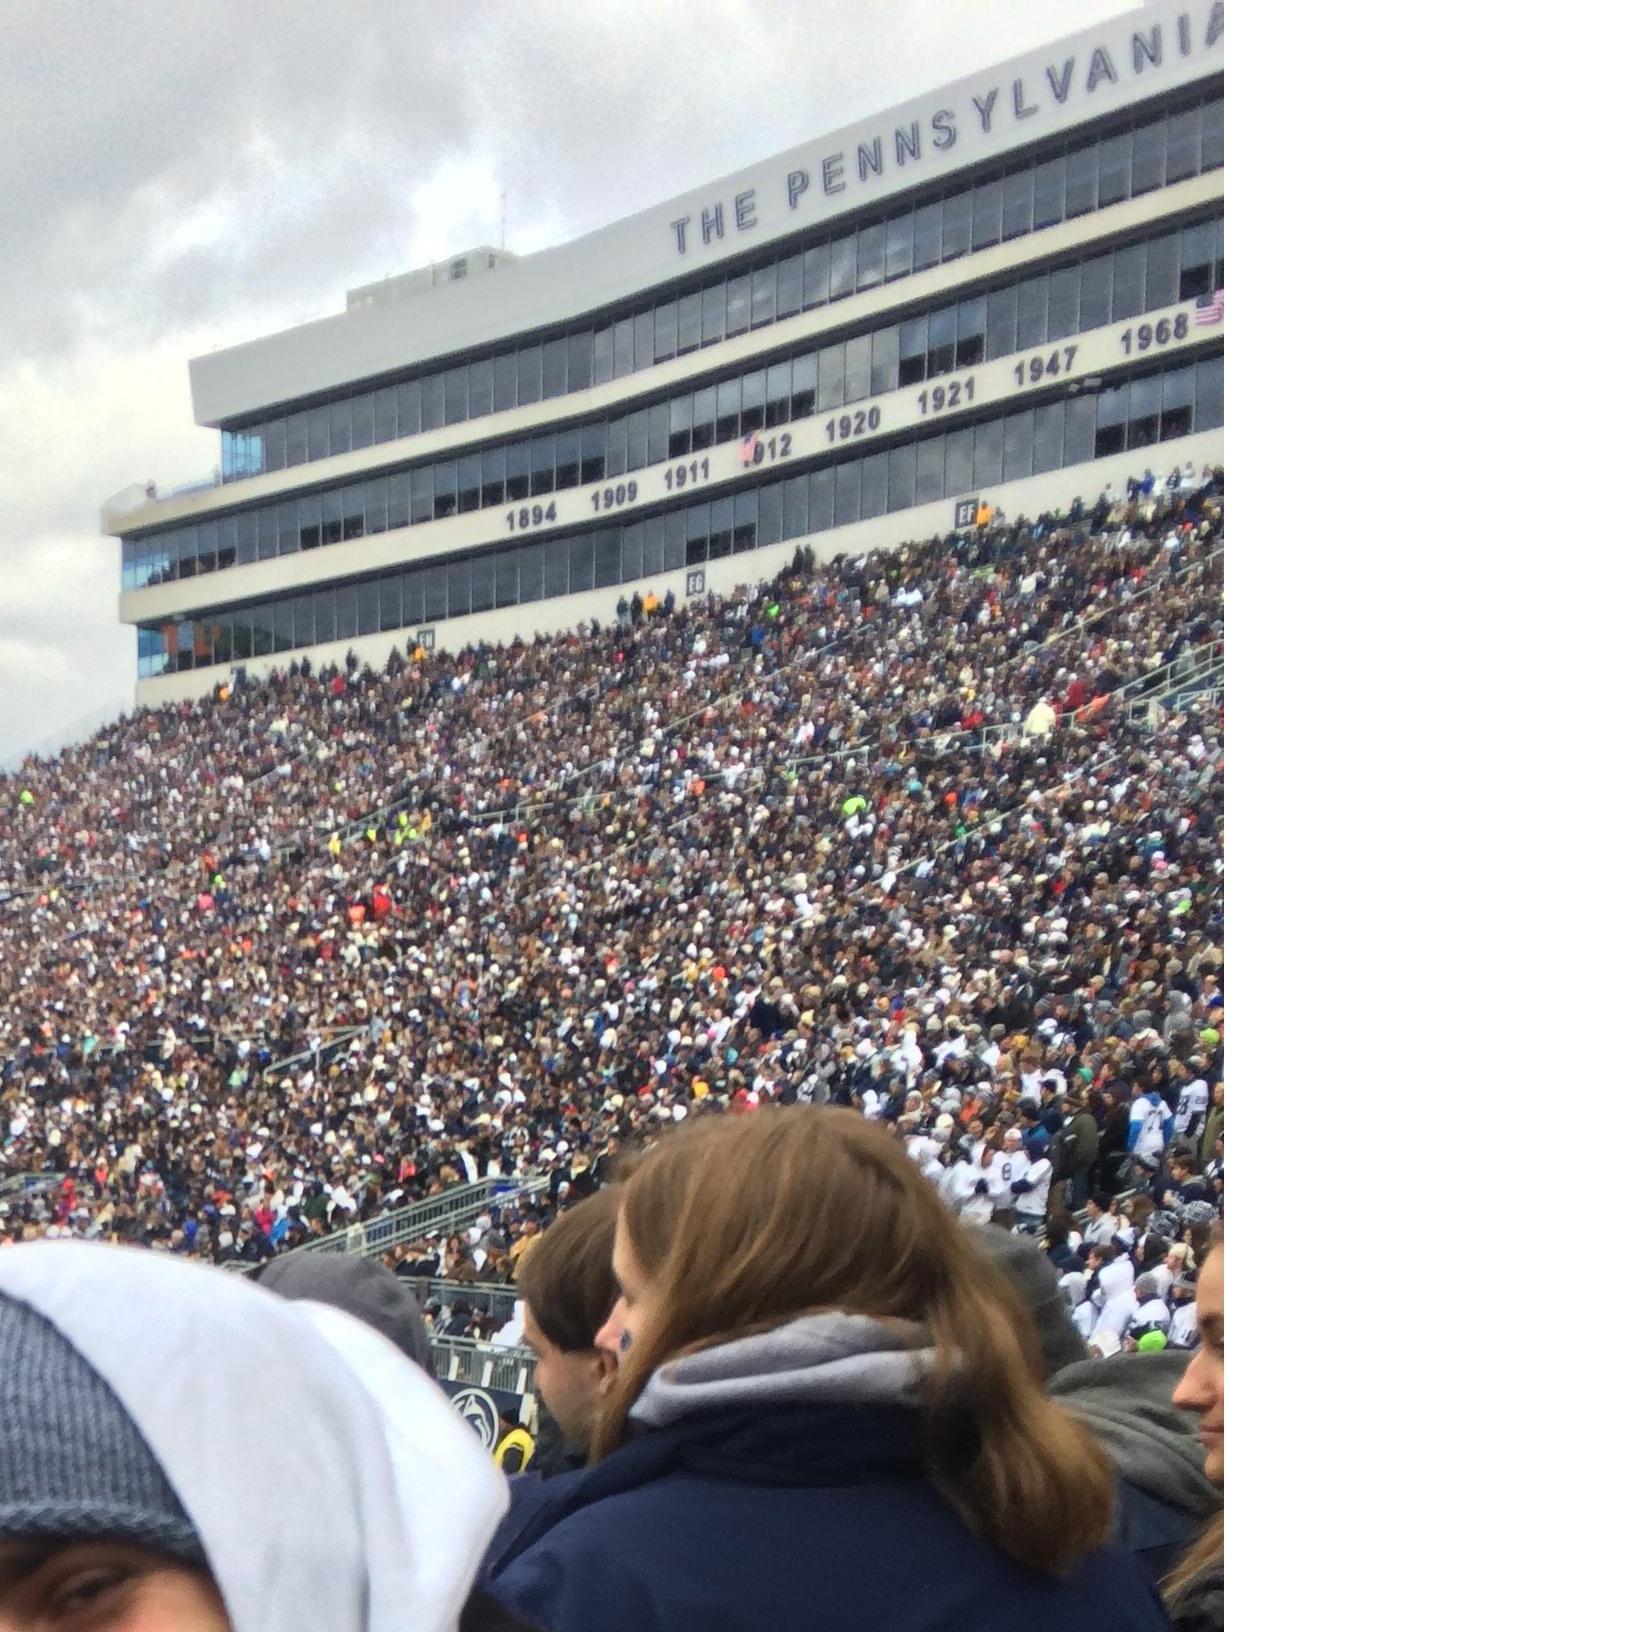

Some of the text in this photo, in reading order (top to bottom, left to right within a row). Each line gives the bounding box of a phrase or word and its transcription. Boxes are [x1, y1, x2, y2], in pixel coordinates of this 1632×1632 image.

[670, 189, 757, 254] THE
[506, 500, 558, 532] 1894
[591, 480, 639, 512] 1909
[664, 458, 711, 491] 1911
[825, 407, 882, 443] 1920
[917, 378, 976, 415] 1921
[1014, 346, 1079, 386] 1947
[1121, 314, 1189, 355] 1968
[689, 574, 703, 593] EG
[1001, 1162, 1013, 1181] 8
